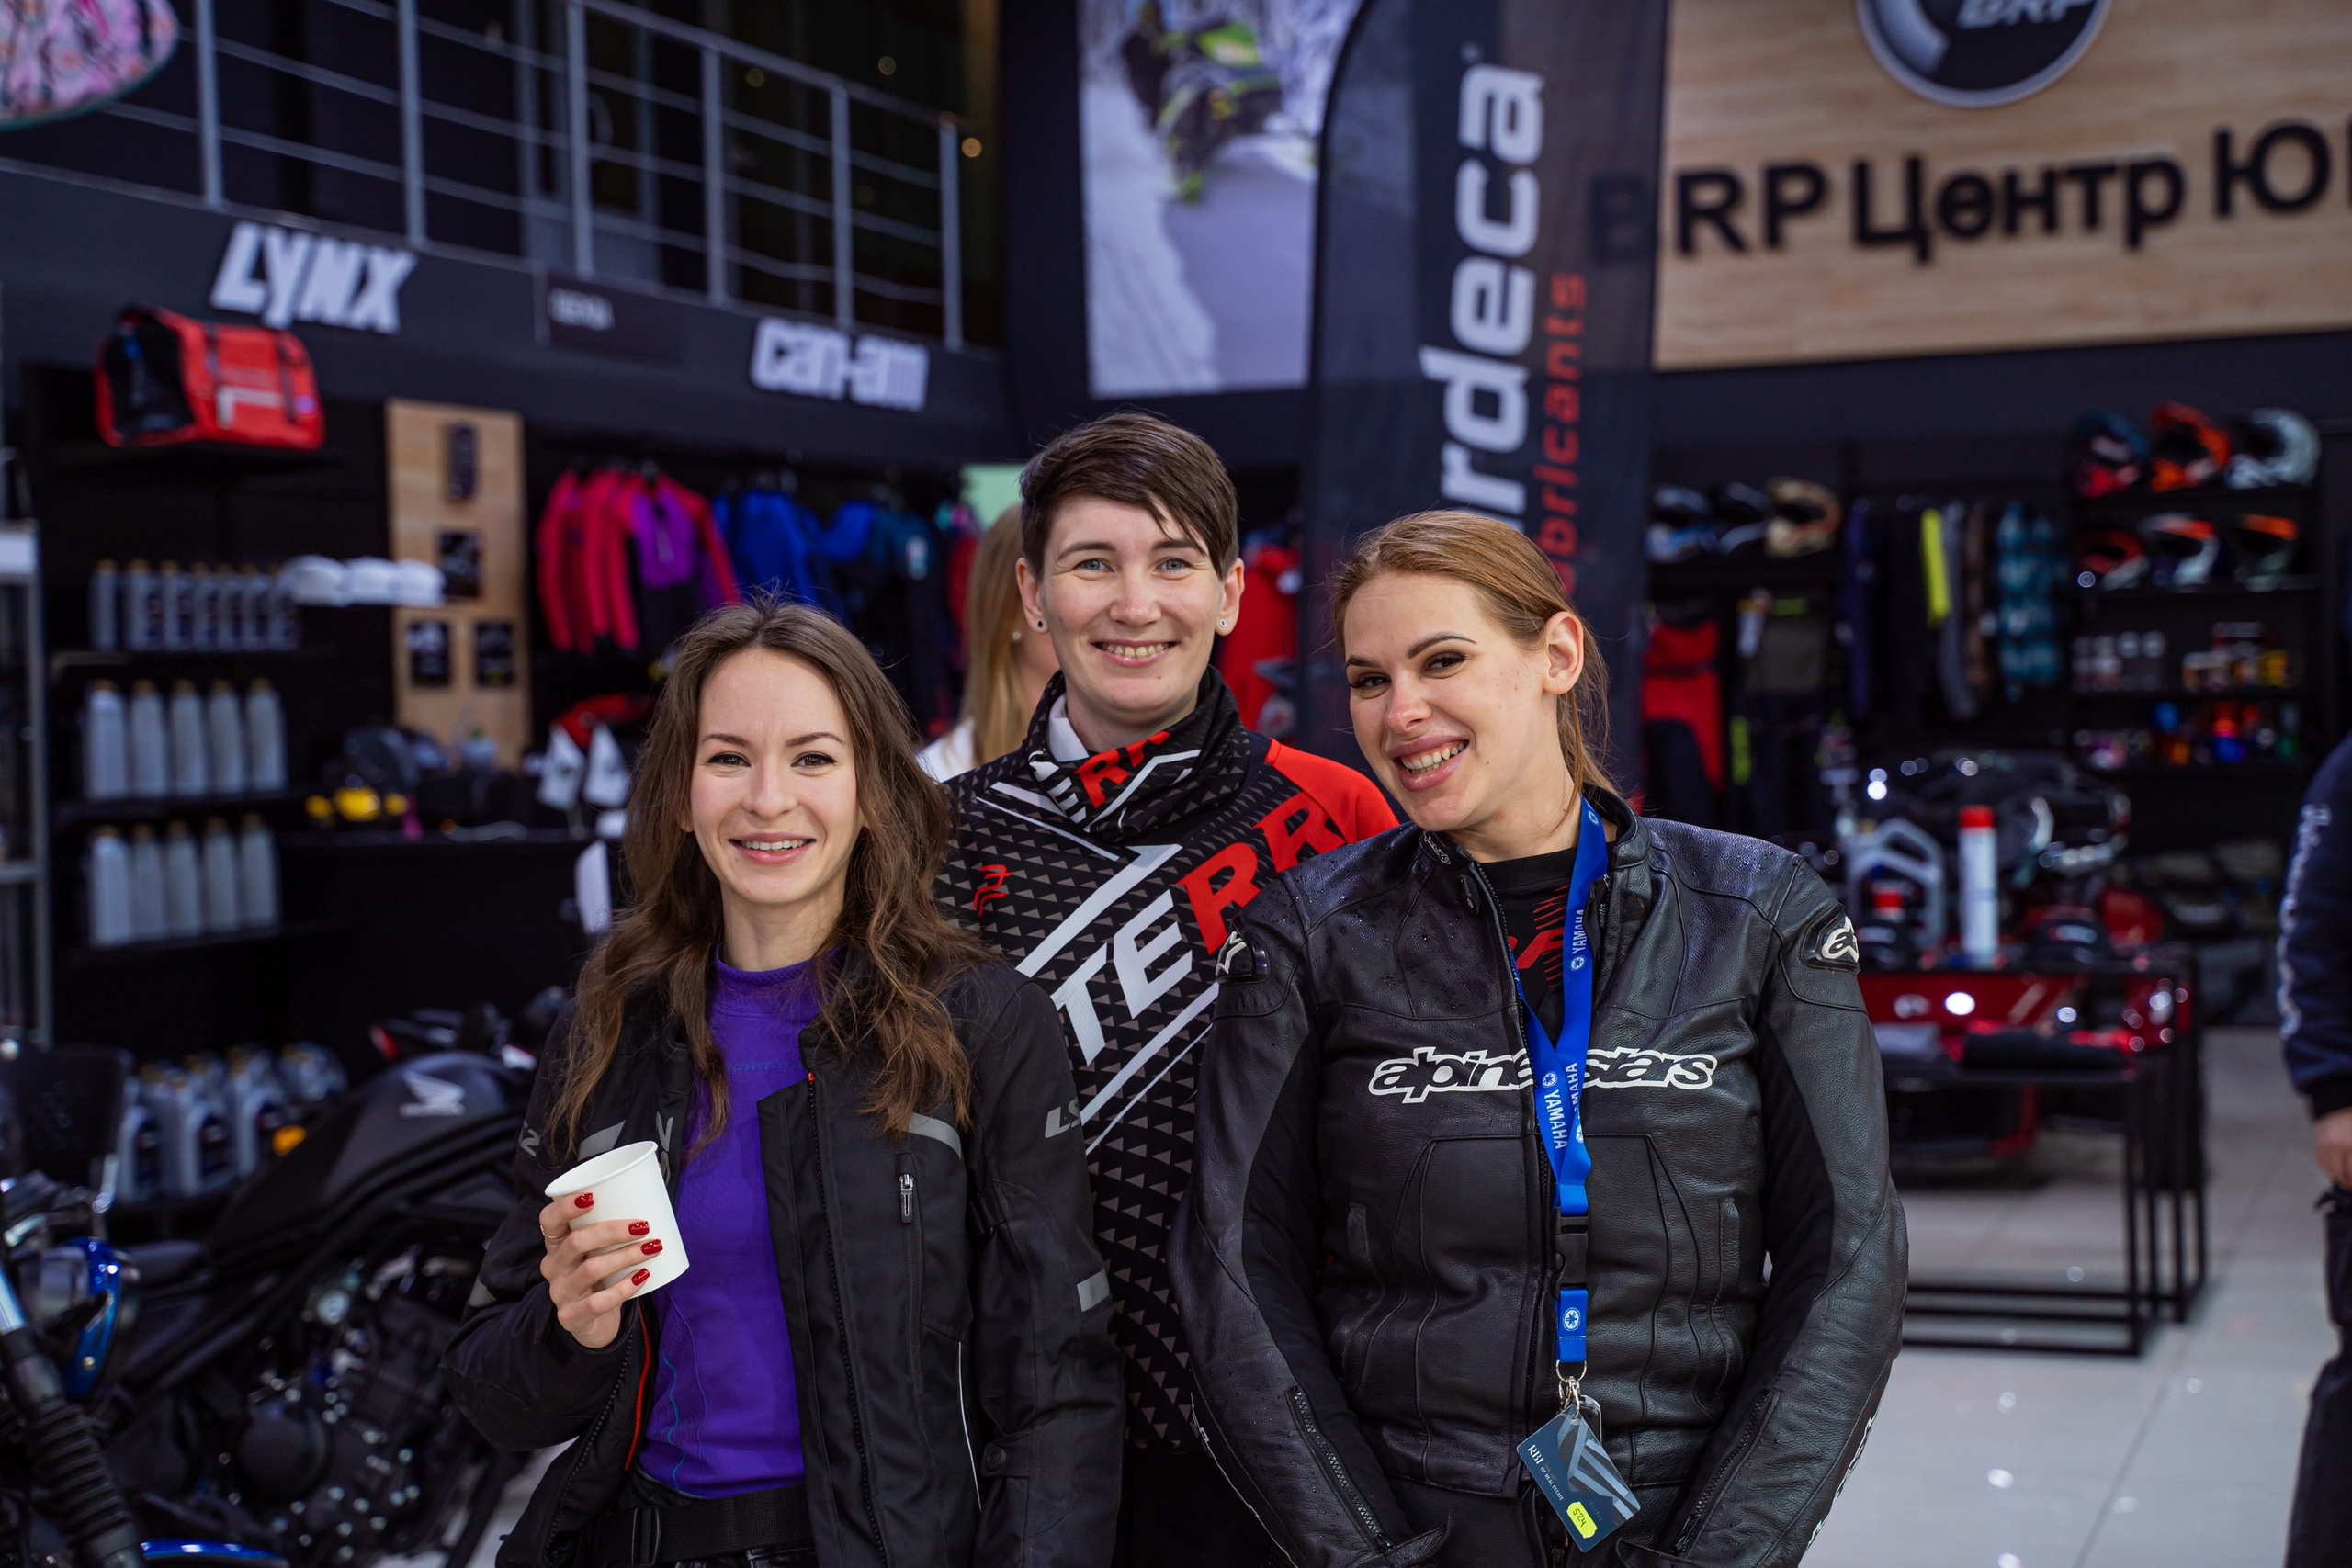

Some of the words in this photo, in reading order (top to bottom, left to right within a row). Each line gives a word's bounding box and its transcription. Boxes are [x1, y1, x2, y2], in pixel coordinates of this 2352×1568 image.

[2212, 116, 2352, 220] Ю
[210, 220, 417, 334] LYNX
[1419, 63, 1544, 531] rdeca
[1544, 1089, 1567, 1149] YAMAHA
[1527, 1444, 1544, 1465] RBI
[1572, 1507, 1587, 1528] 524
